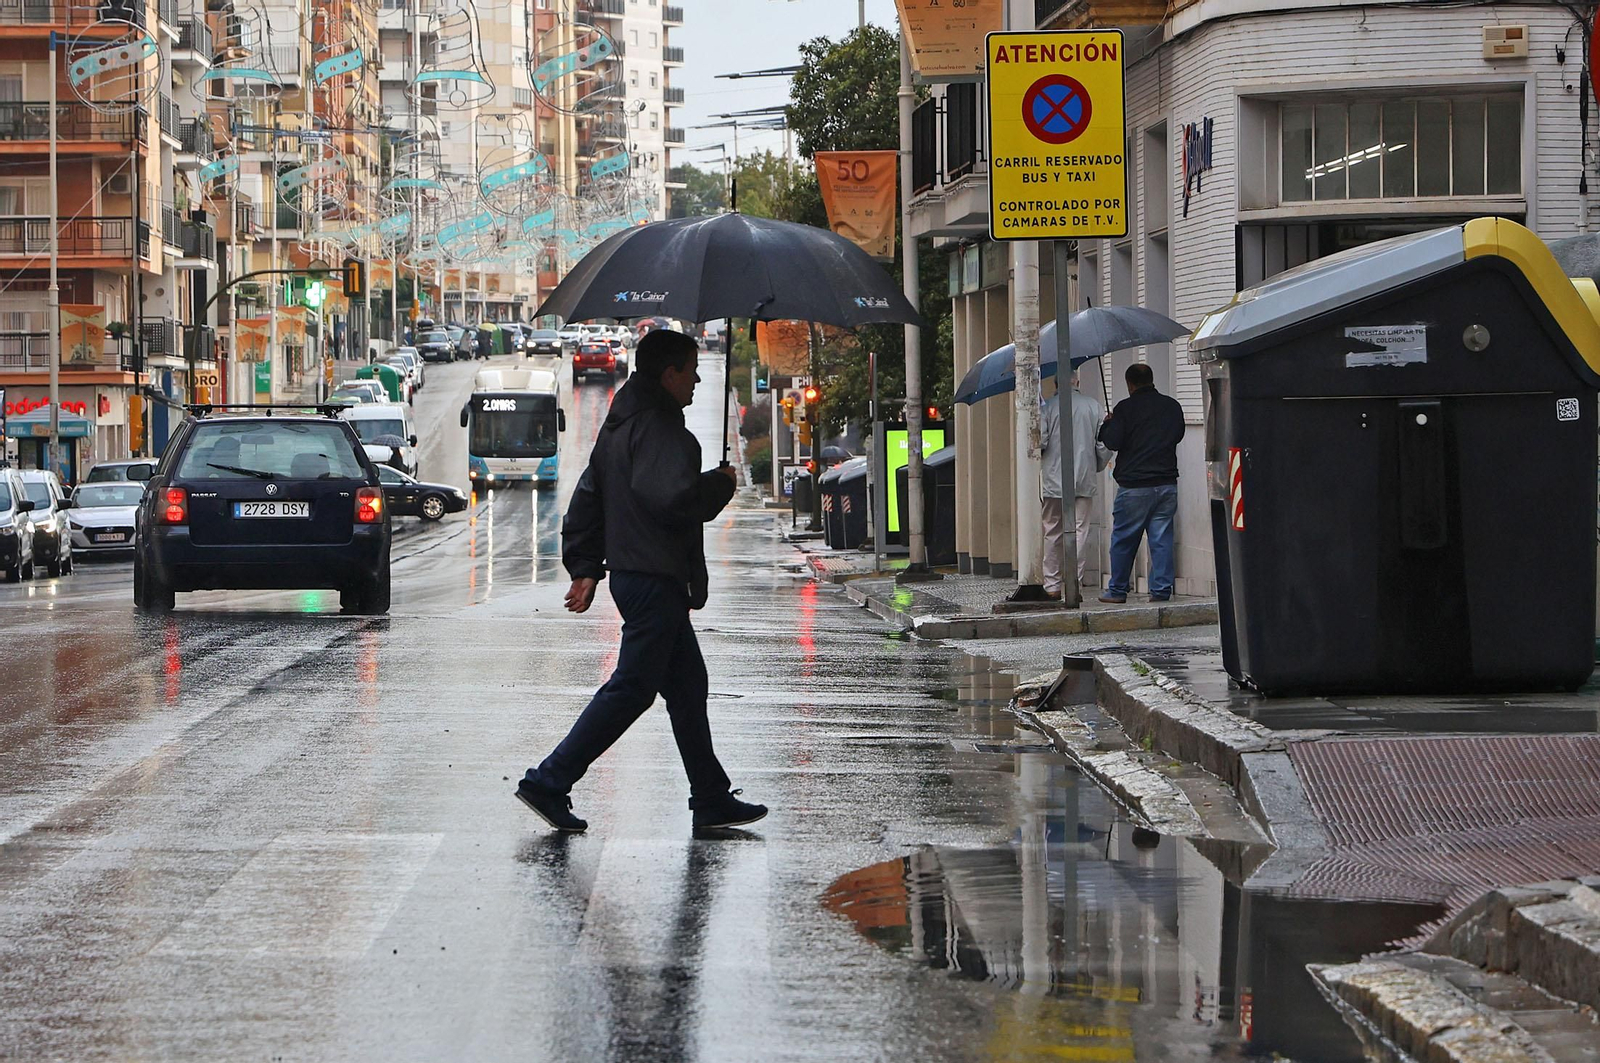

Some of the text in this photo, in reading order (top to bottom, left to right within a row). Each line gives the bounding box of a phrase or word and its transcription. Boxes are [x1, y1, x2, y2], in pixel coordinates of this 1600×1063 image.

[994, 37, 1117, 63] ATENCIÓN
[995, 154, 1122, 168] CARRIL RESERVADO
[837, 159, 870, 182] 50
[1022, 171, 1096, 183] BUS Y TAXI
[999, 198, 1120, 211] CONTROLADO POR
[1002, 214, 1119, 228] CAMARAS DE T.V.
[3, 396, 87, 416] odafne
[244, 503, 306, 516] 2728 DSY
